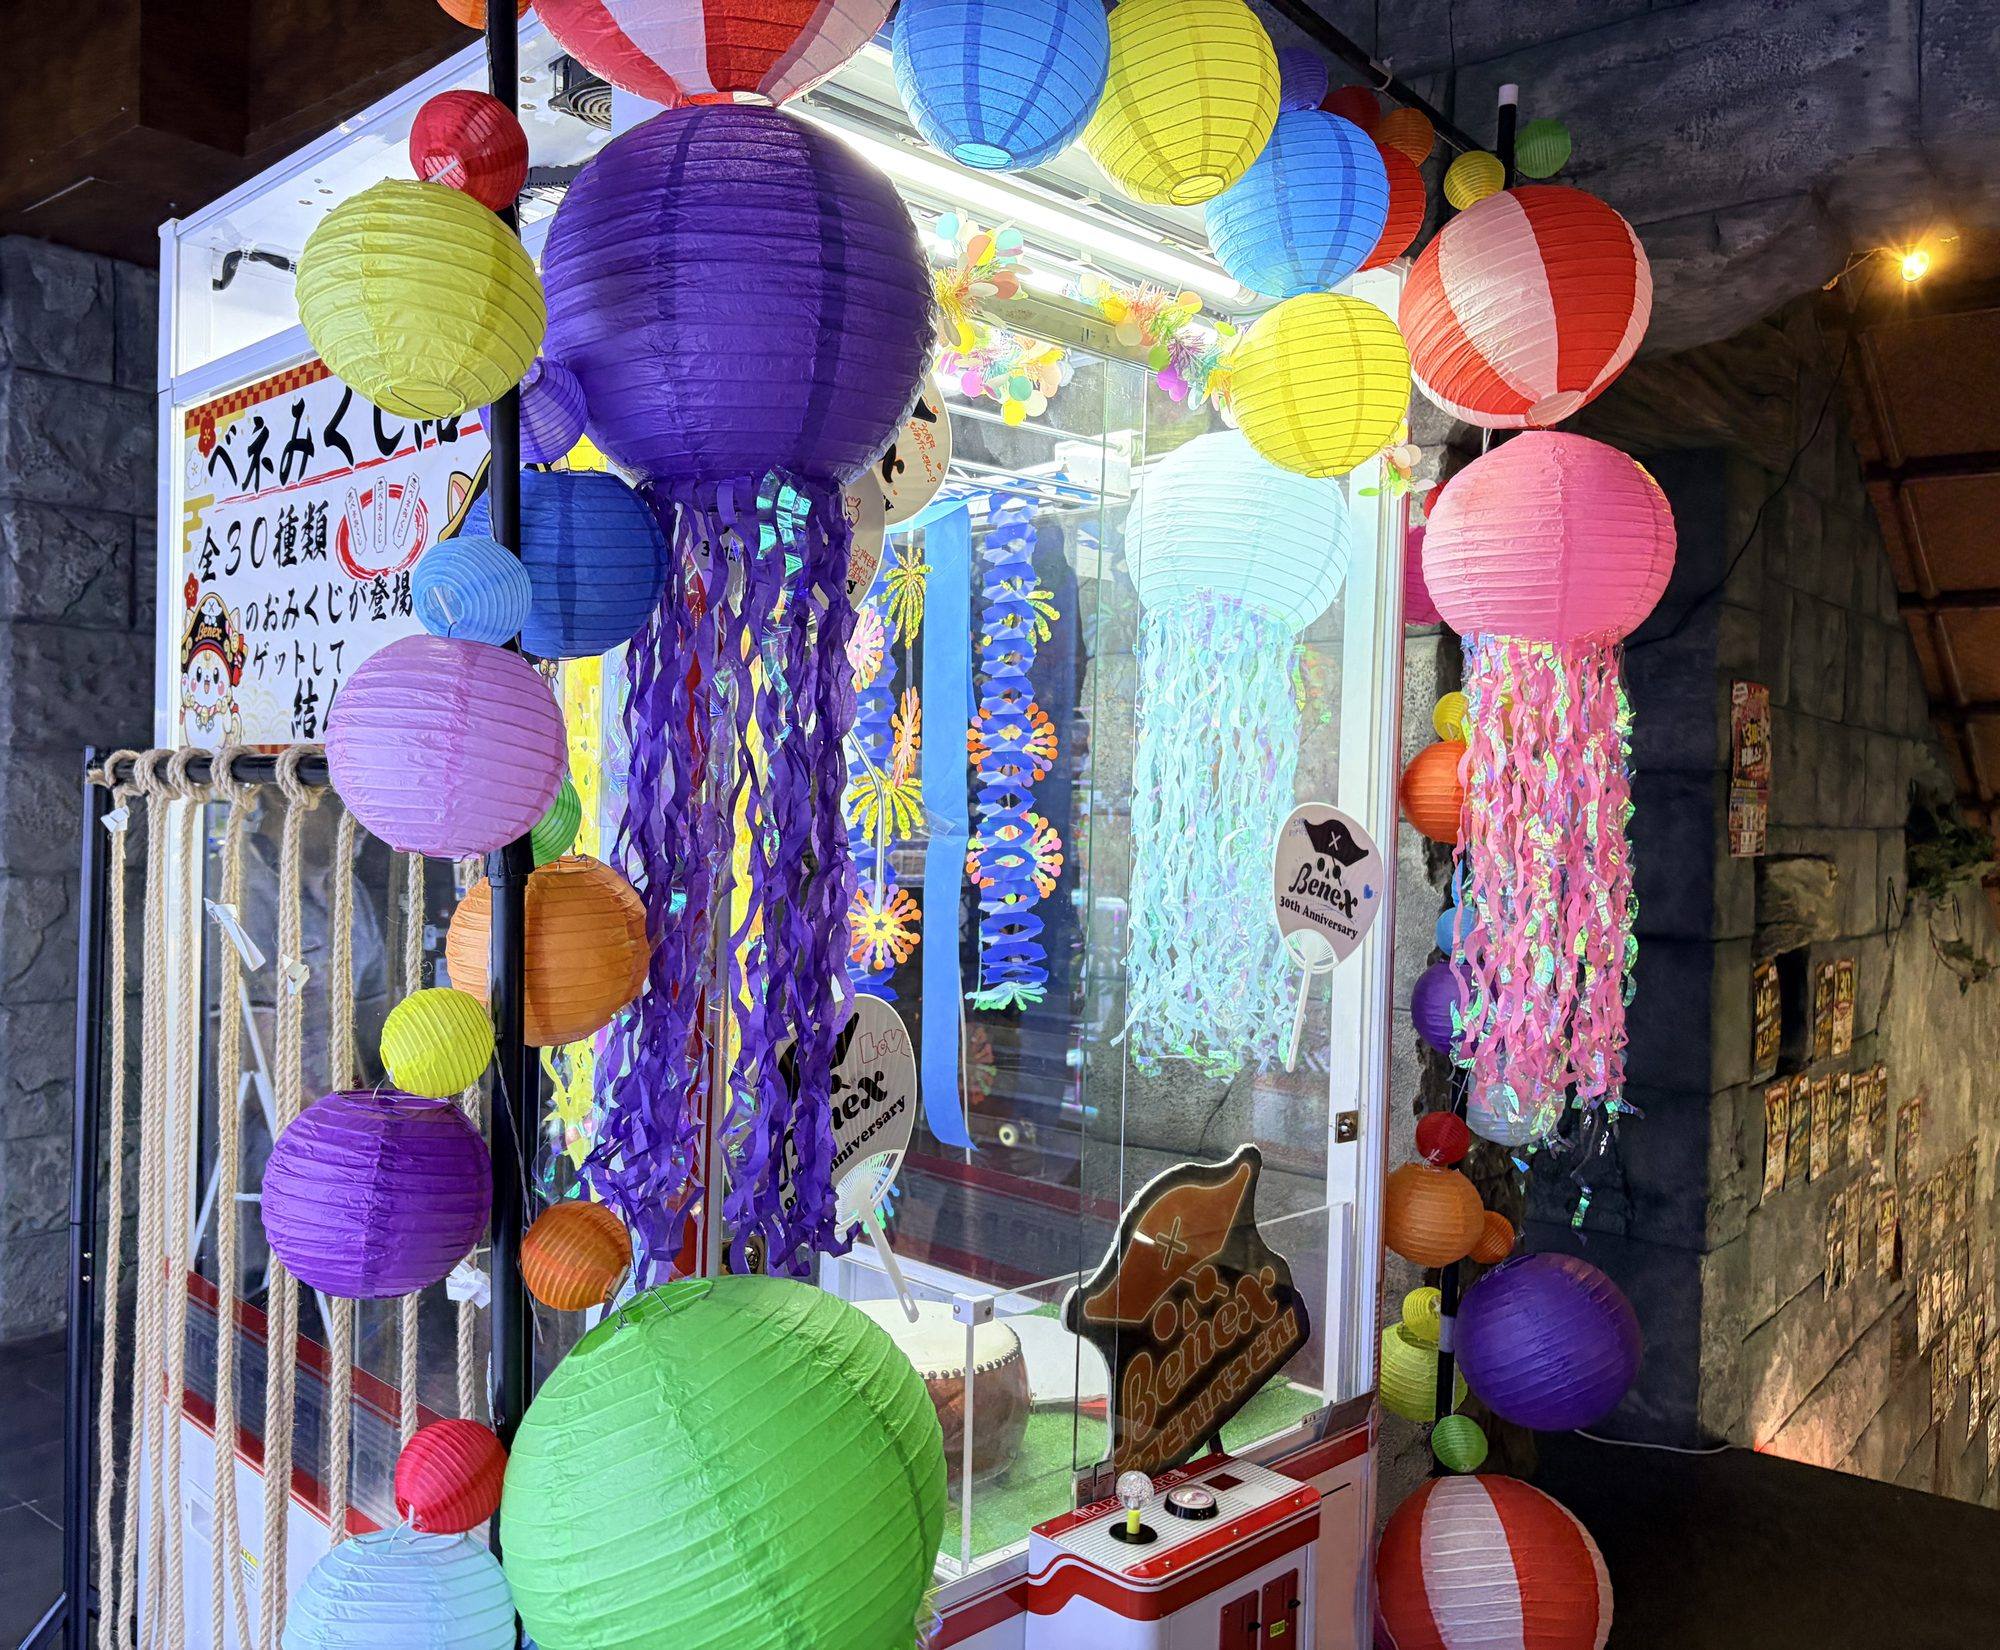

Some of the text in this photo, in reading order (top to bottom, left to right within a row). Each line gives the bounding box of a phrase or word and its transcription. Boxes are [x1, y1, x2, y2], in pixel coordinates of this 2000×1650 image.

[198, 500, 330, 582] 全30種類
[246, 570, 413, 630] のおみくじが登場
[252, 640, 346, 682] ゲットして
[1279, 896, 1359, 941] 30th Anniversary
[1288, 862, 1358, 919] Benex
[1114, 1266, 1278, 1468] Benex
